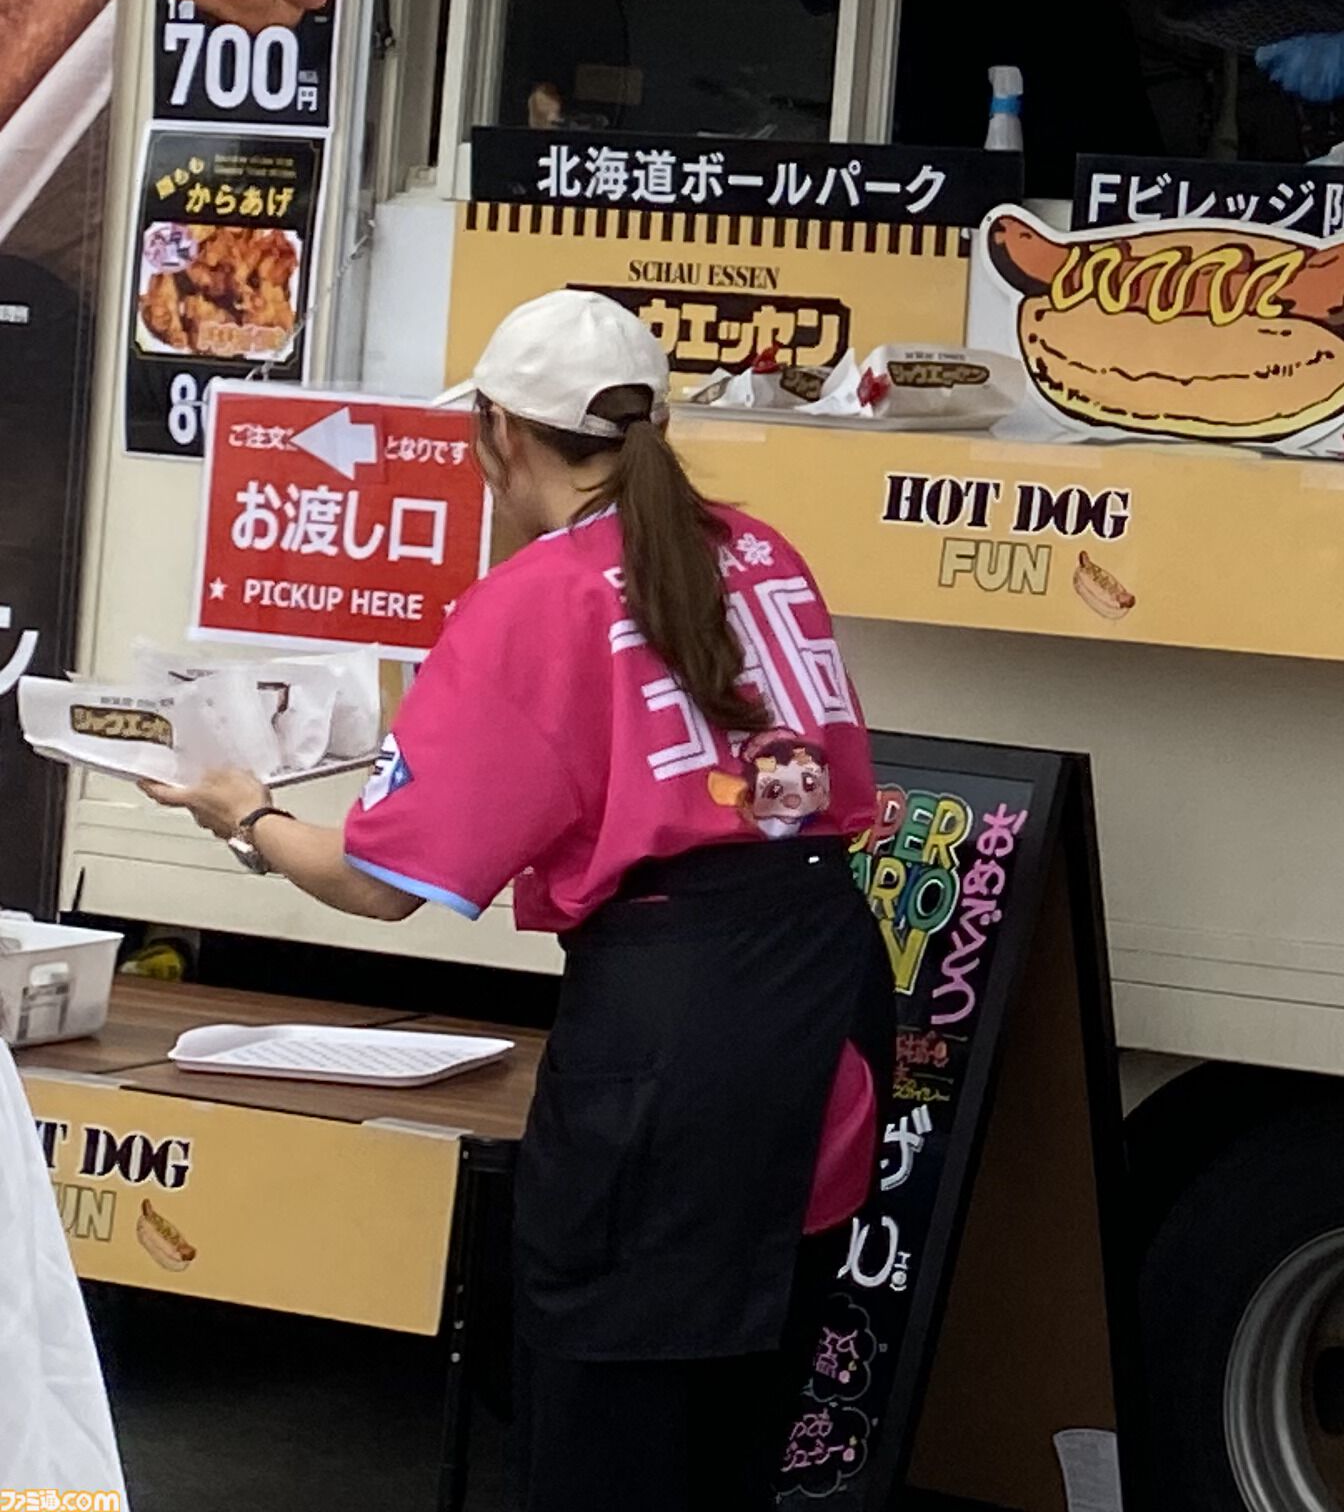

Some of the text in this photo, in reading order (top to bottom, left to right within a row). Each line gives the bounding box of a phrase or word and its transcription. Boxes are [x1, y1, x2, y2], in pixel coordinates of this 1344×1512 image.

[185, 182, 295, 218] からあげ
[537, 144, 947, 215] 北海道ボールパーク
[628, 259, 781, 290] SCHAU ESSEN
[638, 297, 841, 367] ウエッセン
[230, 480, 449, 566] お渡し口
[882, 474, 1130, 540] HOT DOG
[938, 536, 1053, 596] FUN
[242, 578, 424, 620] PICKUP HERE
[79, 1127, 191, 1189] DOG
[54, 1181, 117, 1242] UN
